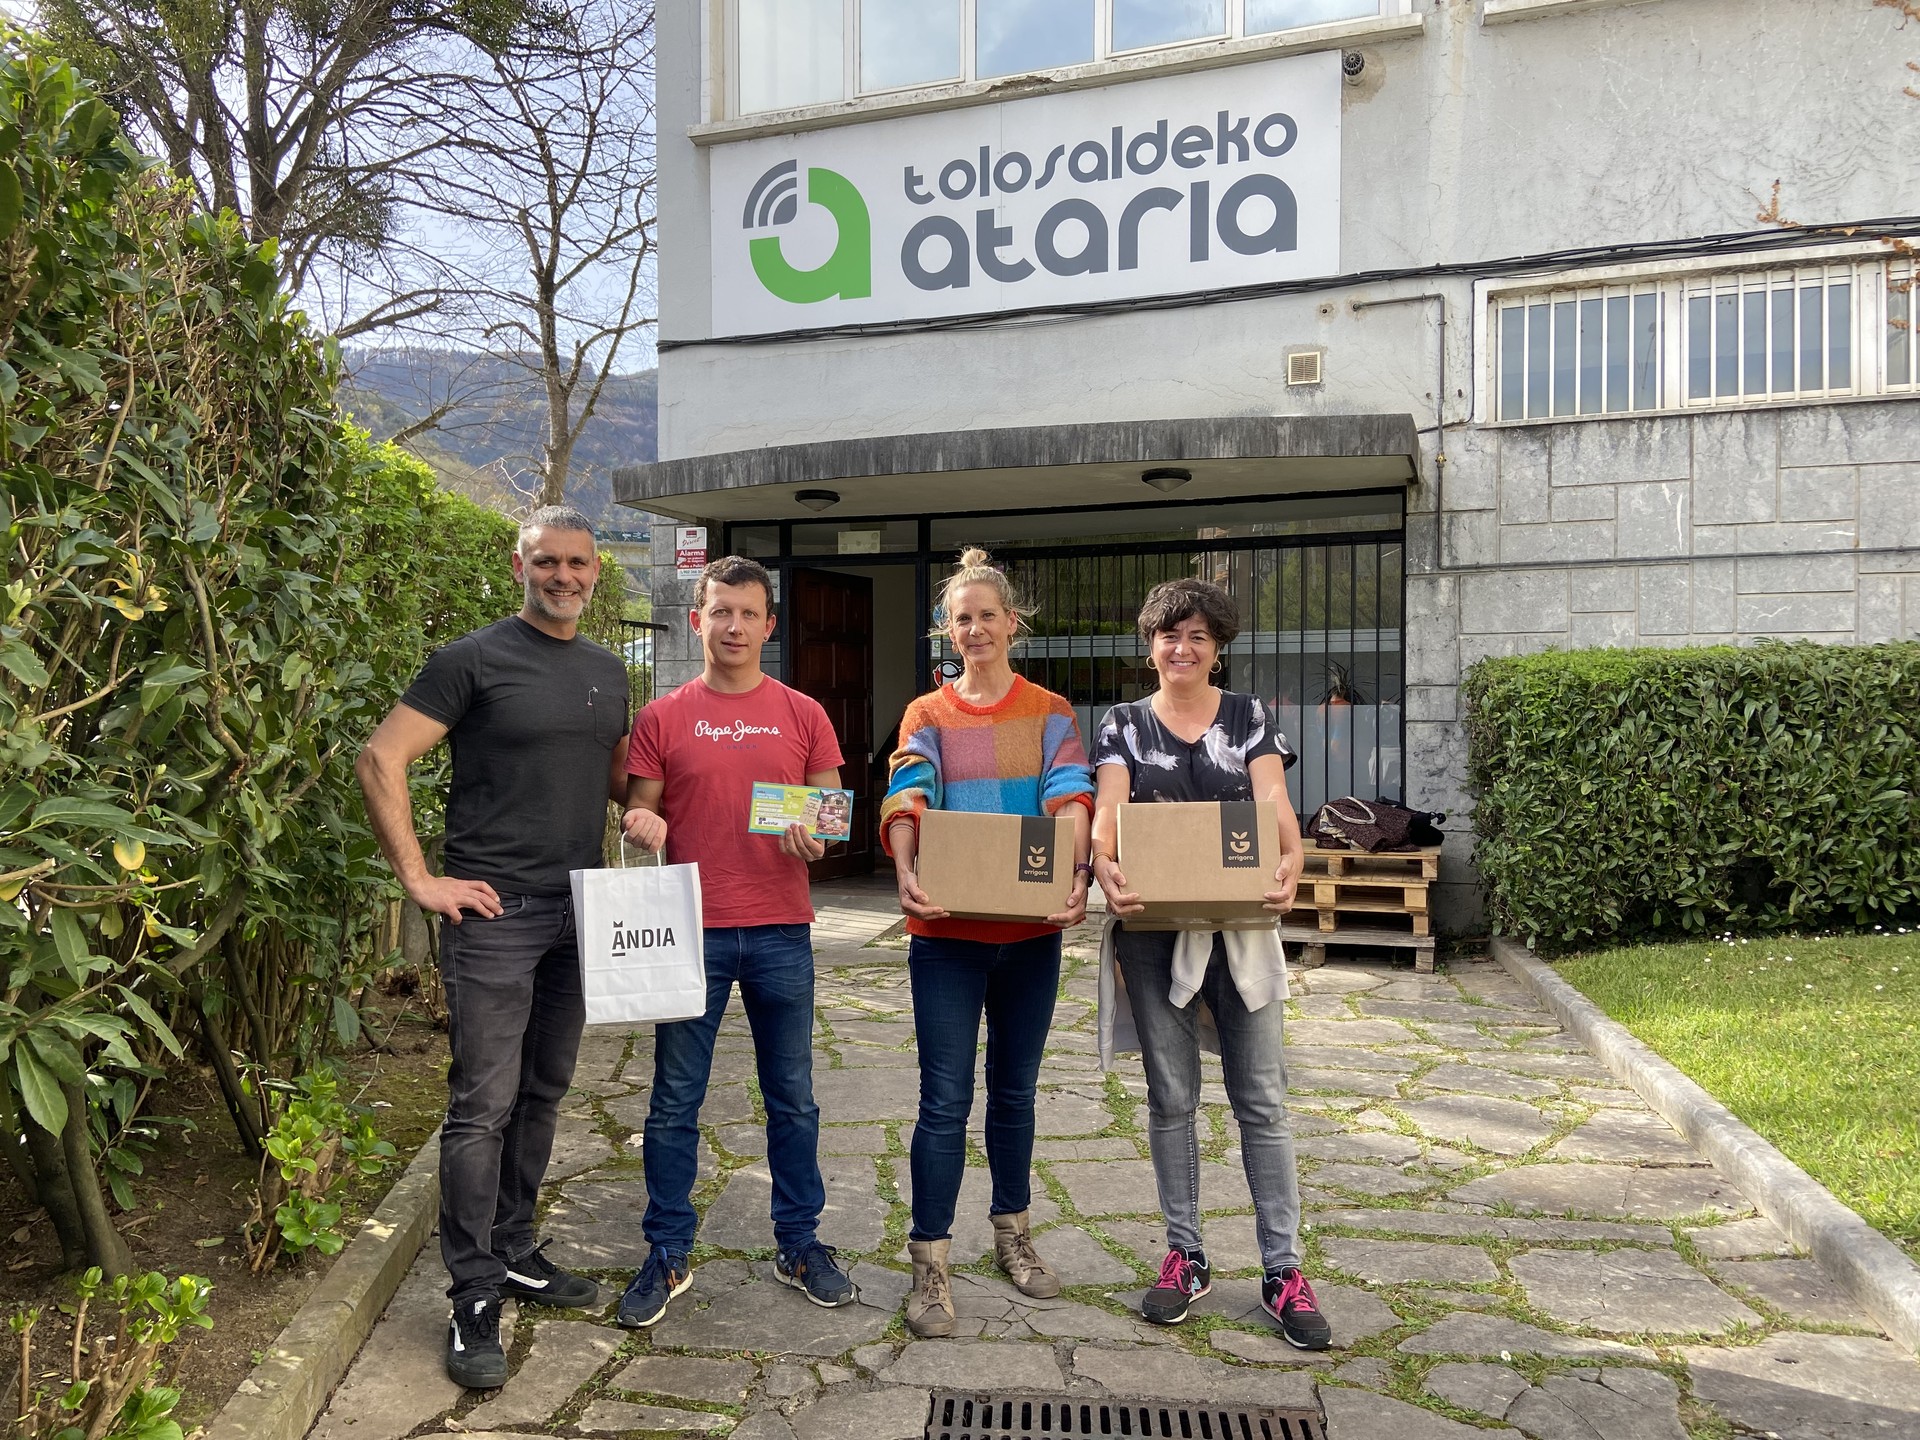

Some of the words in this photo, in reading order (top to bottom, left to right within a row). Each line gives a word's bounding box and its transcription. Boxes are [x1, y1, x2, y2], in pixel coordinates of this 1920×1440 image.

[903, 110, 1298, 205] tolosaldeko
[900, 173, 1298, 291] ataria
[694, 720, 733, 742] Pepe
[732, 719, 781, 742] Jeans
[1228, 854, 1254, 862] errigora
[1023, 869, 1049, 877] errigora
